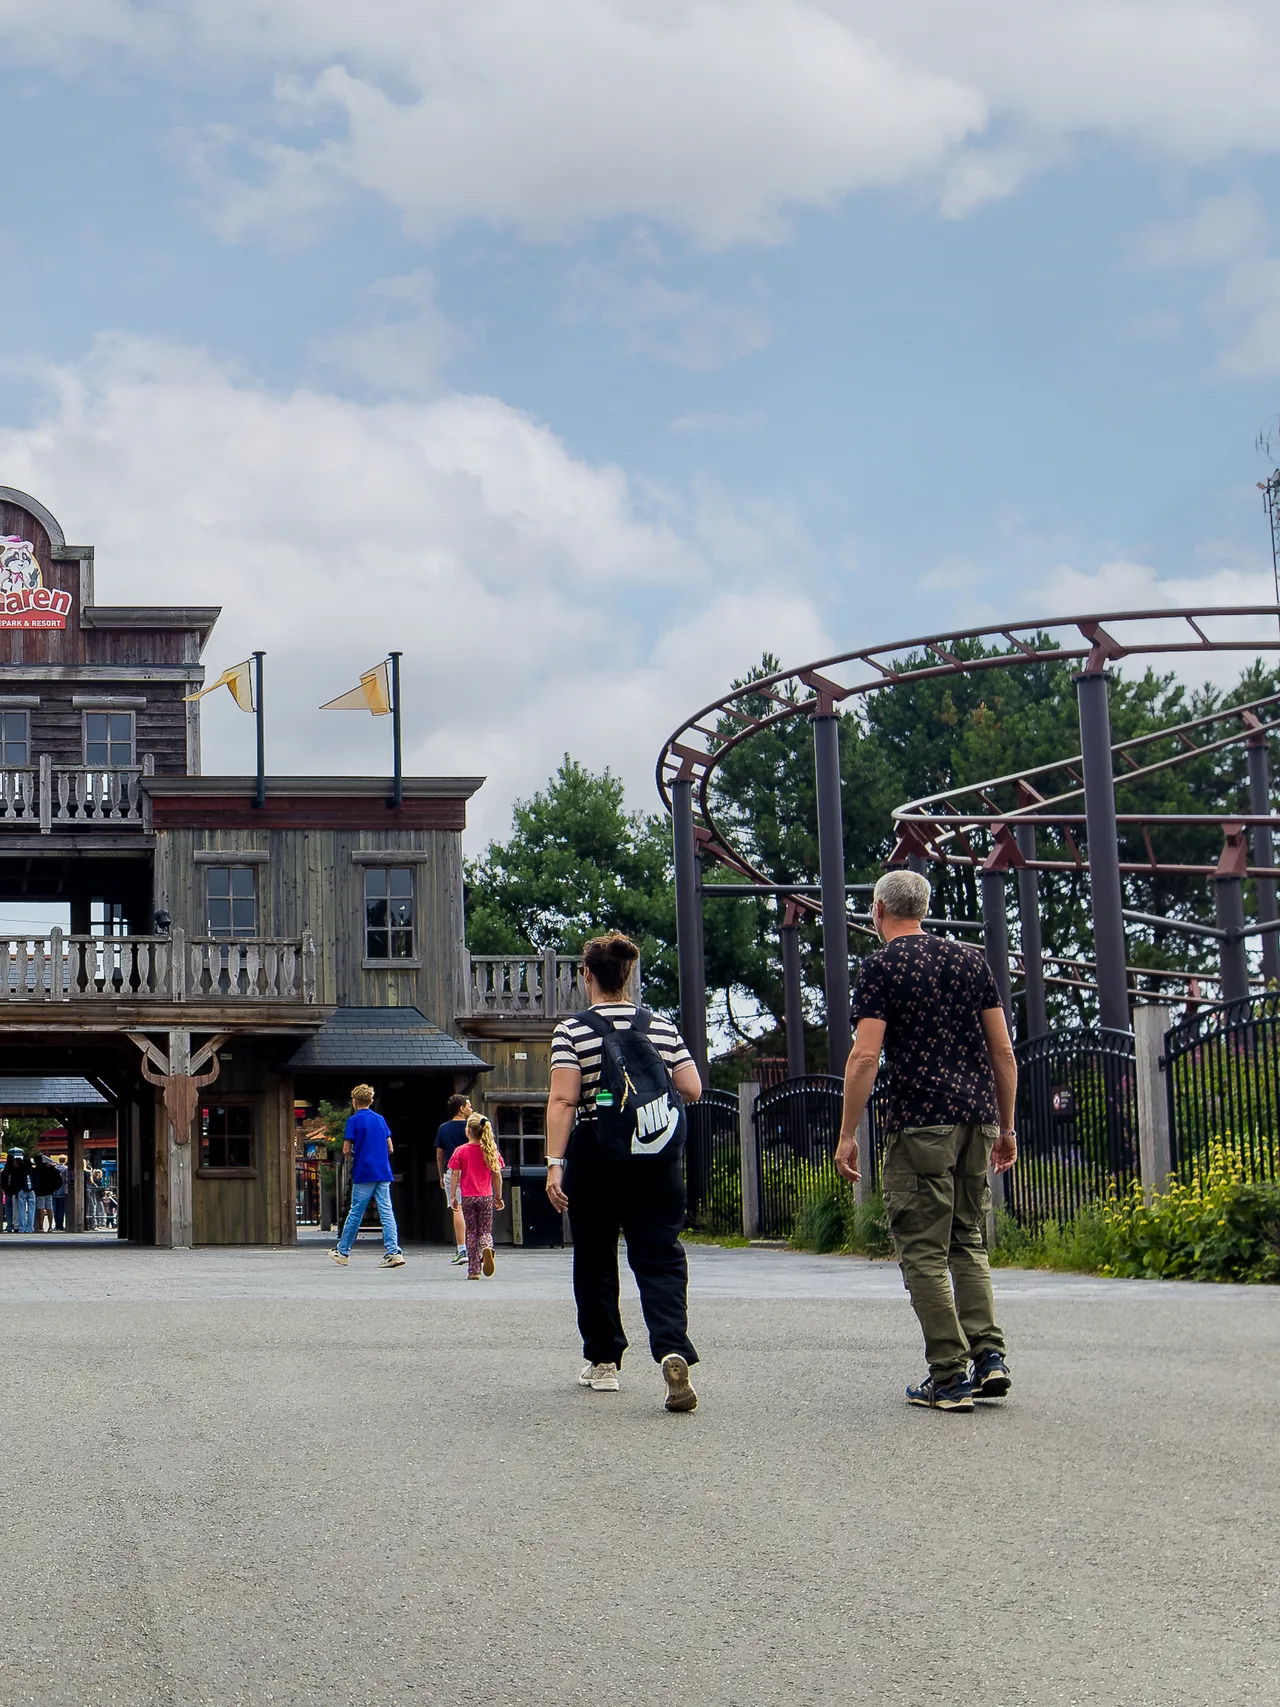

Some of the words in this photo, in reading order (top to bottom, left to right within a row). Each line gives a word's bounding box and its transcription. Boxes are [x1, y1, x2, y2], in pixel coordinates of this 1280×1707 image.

[23, 619, 30, 627] &
[31, 619, 62, 627] RESORT
[636, 1092, 671, 1138] NIK
